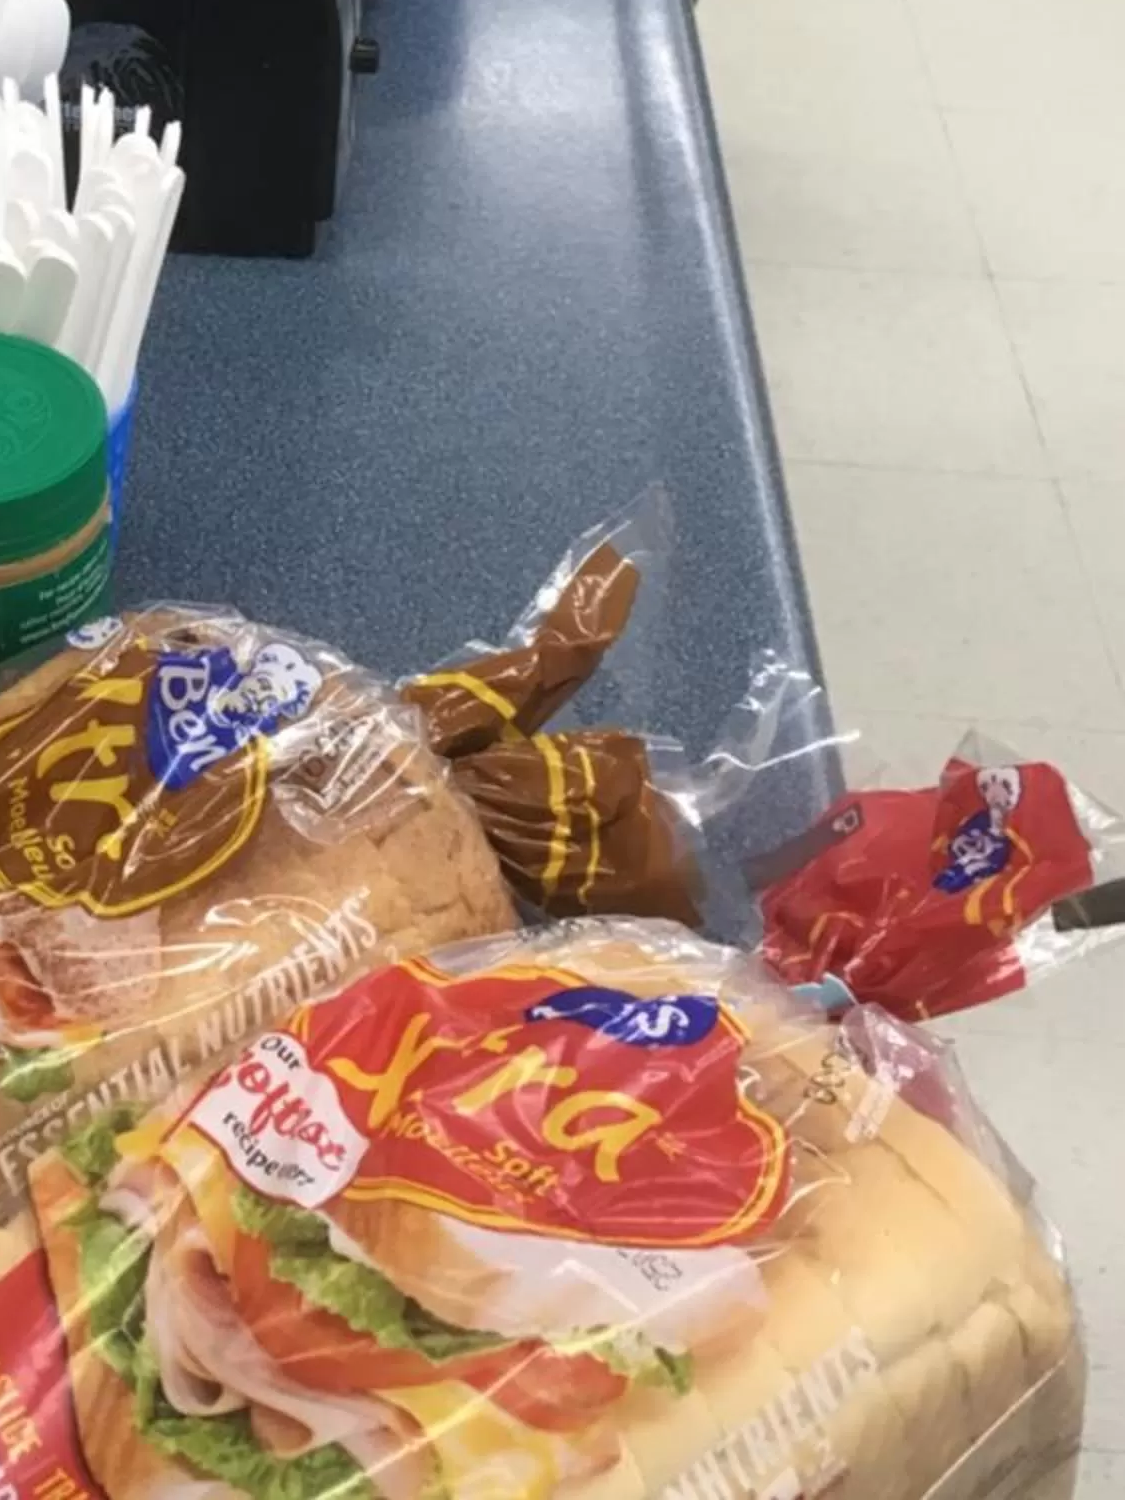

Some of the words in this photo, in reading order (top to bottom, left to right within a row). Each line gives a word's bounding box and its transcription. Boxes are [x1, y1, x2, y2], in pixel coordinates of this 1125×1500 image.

[197, 902, 377, 1056] NUTRIENTS
[259, 1035, 303, 1071] Our
[483, 1139, 560, 1197] Soft
